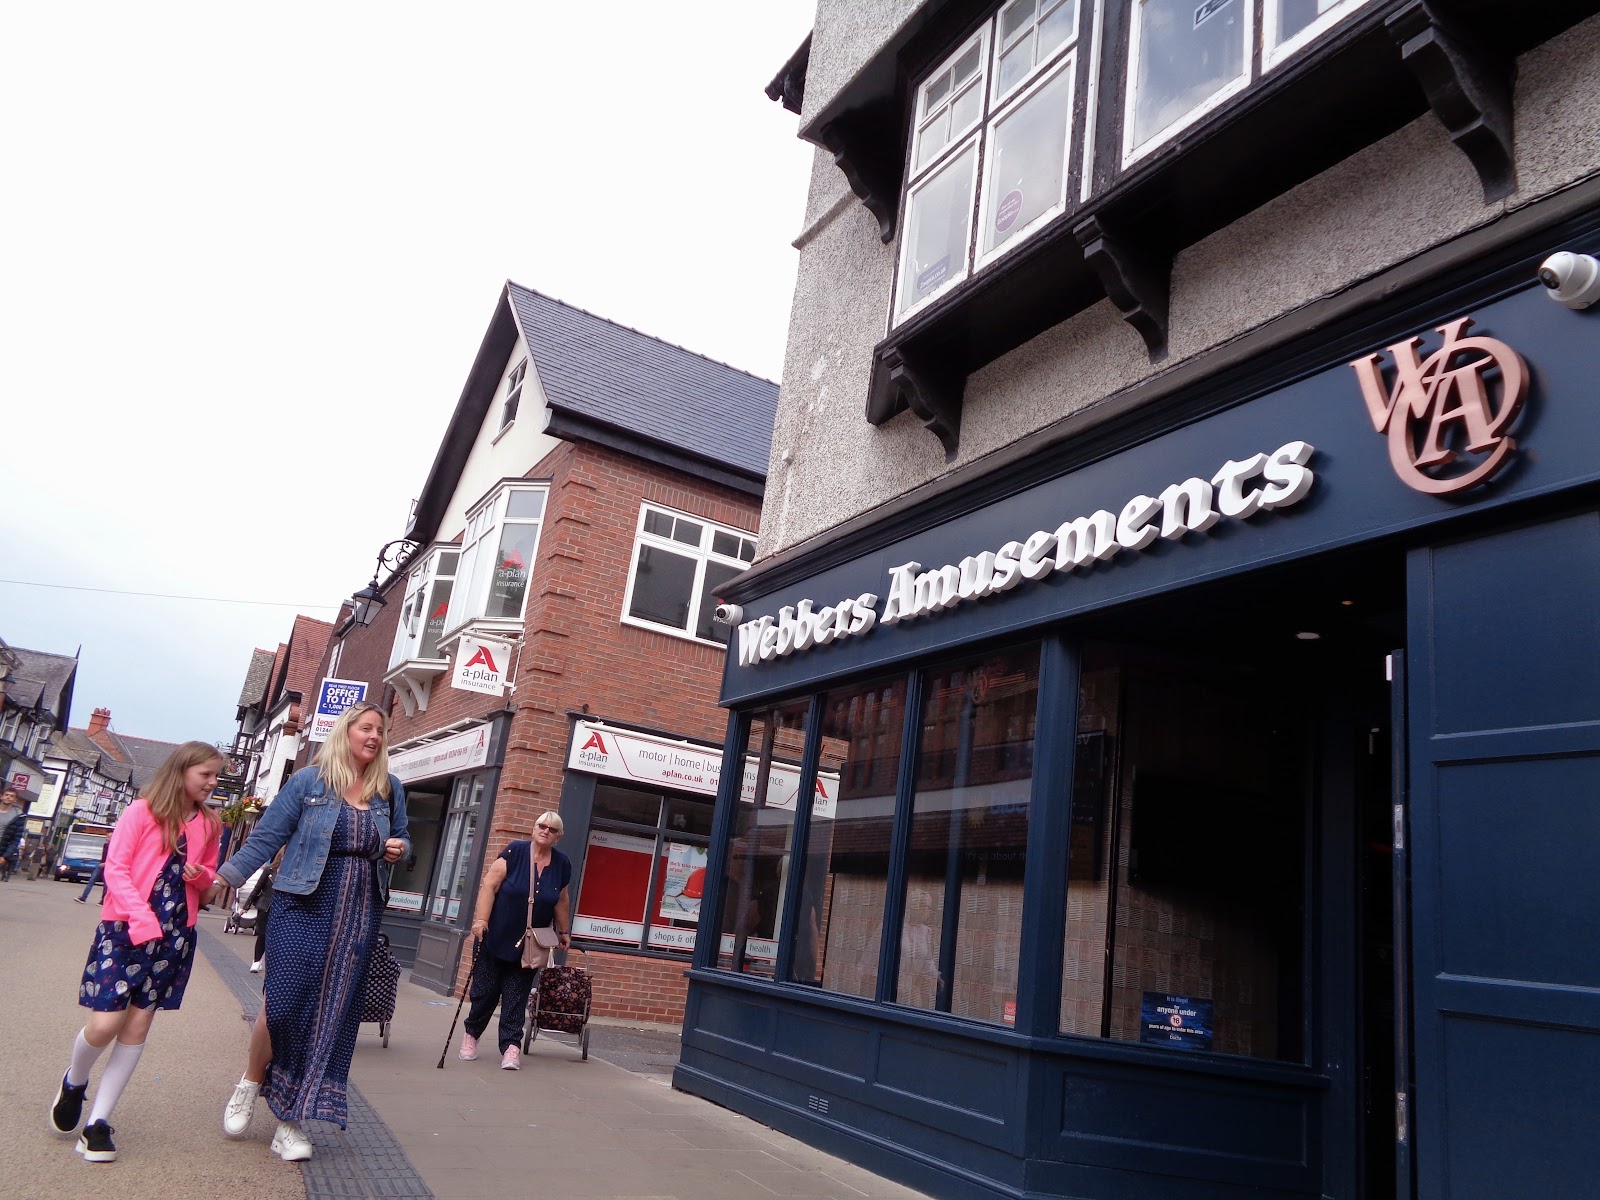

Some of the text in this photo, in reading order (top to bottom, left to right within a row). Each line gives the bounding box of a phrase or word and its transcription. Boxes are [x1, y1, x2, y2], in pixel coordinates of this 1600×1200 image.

[738, 440, 1315, 667] Webbers Amusements
[498, 568, 526, 578] a-plan
[496, 580, 525, 588] insurance
[462, 668, 498, 683] a-plan
[460, 678, 496, 691] insurance
[327, 687, 360, 699] OFFICE
[326, 695, 358, 706] TO LET
[580, 751, 608, 763] a-plan
[638, 749, 667, 763] motor
[674, 754, 701, 770] home
[578, 759, 606, 770] insurance
[662, 769, 703, 783] aplan.co.uk
[590, 922, 624, 936] landlords
[654, 931, 697, 944] shops & off
[749, 943, 771, 954] health
[1157, 1006, 1196, 1016] anyone under
